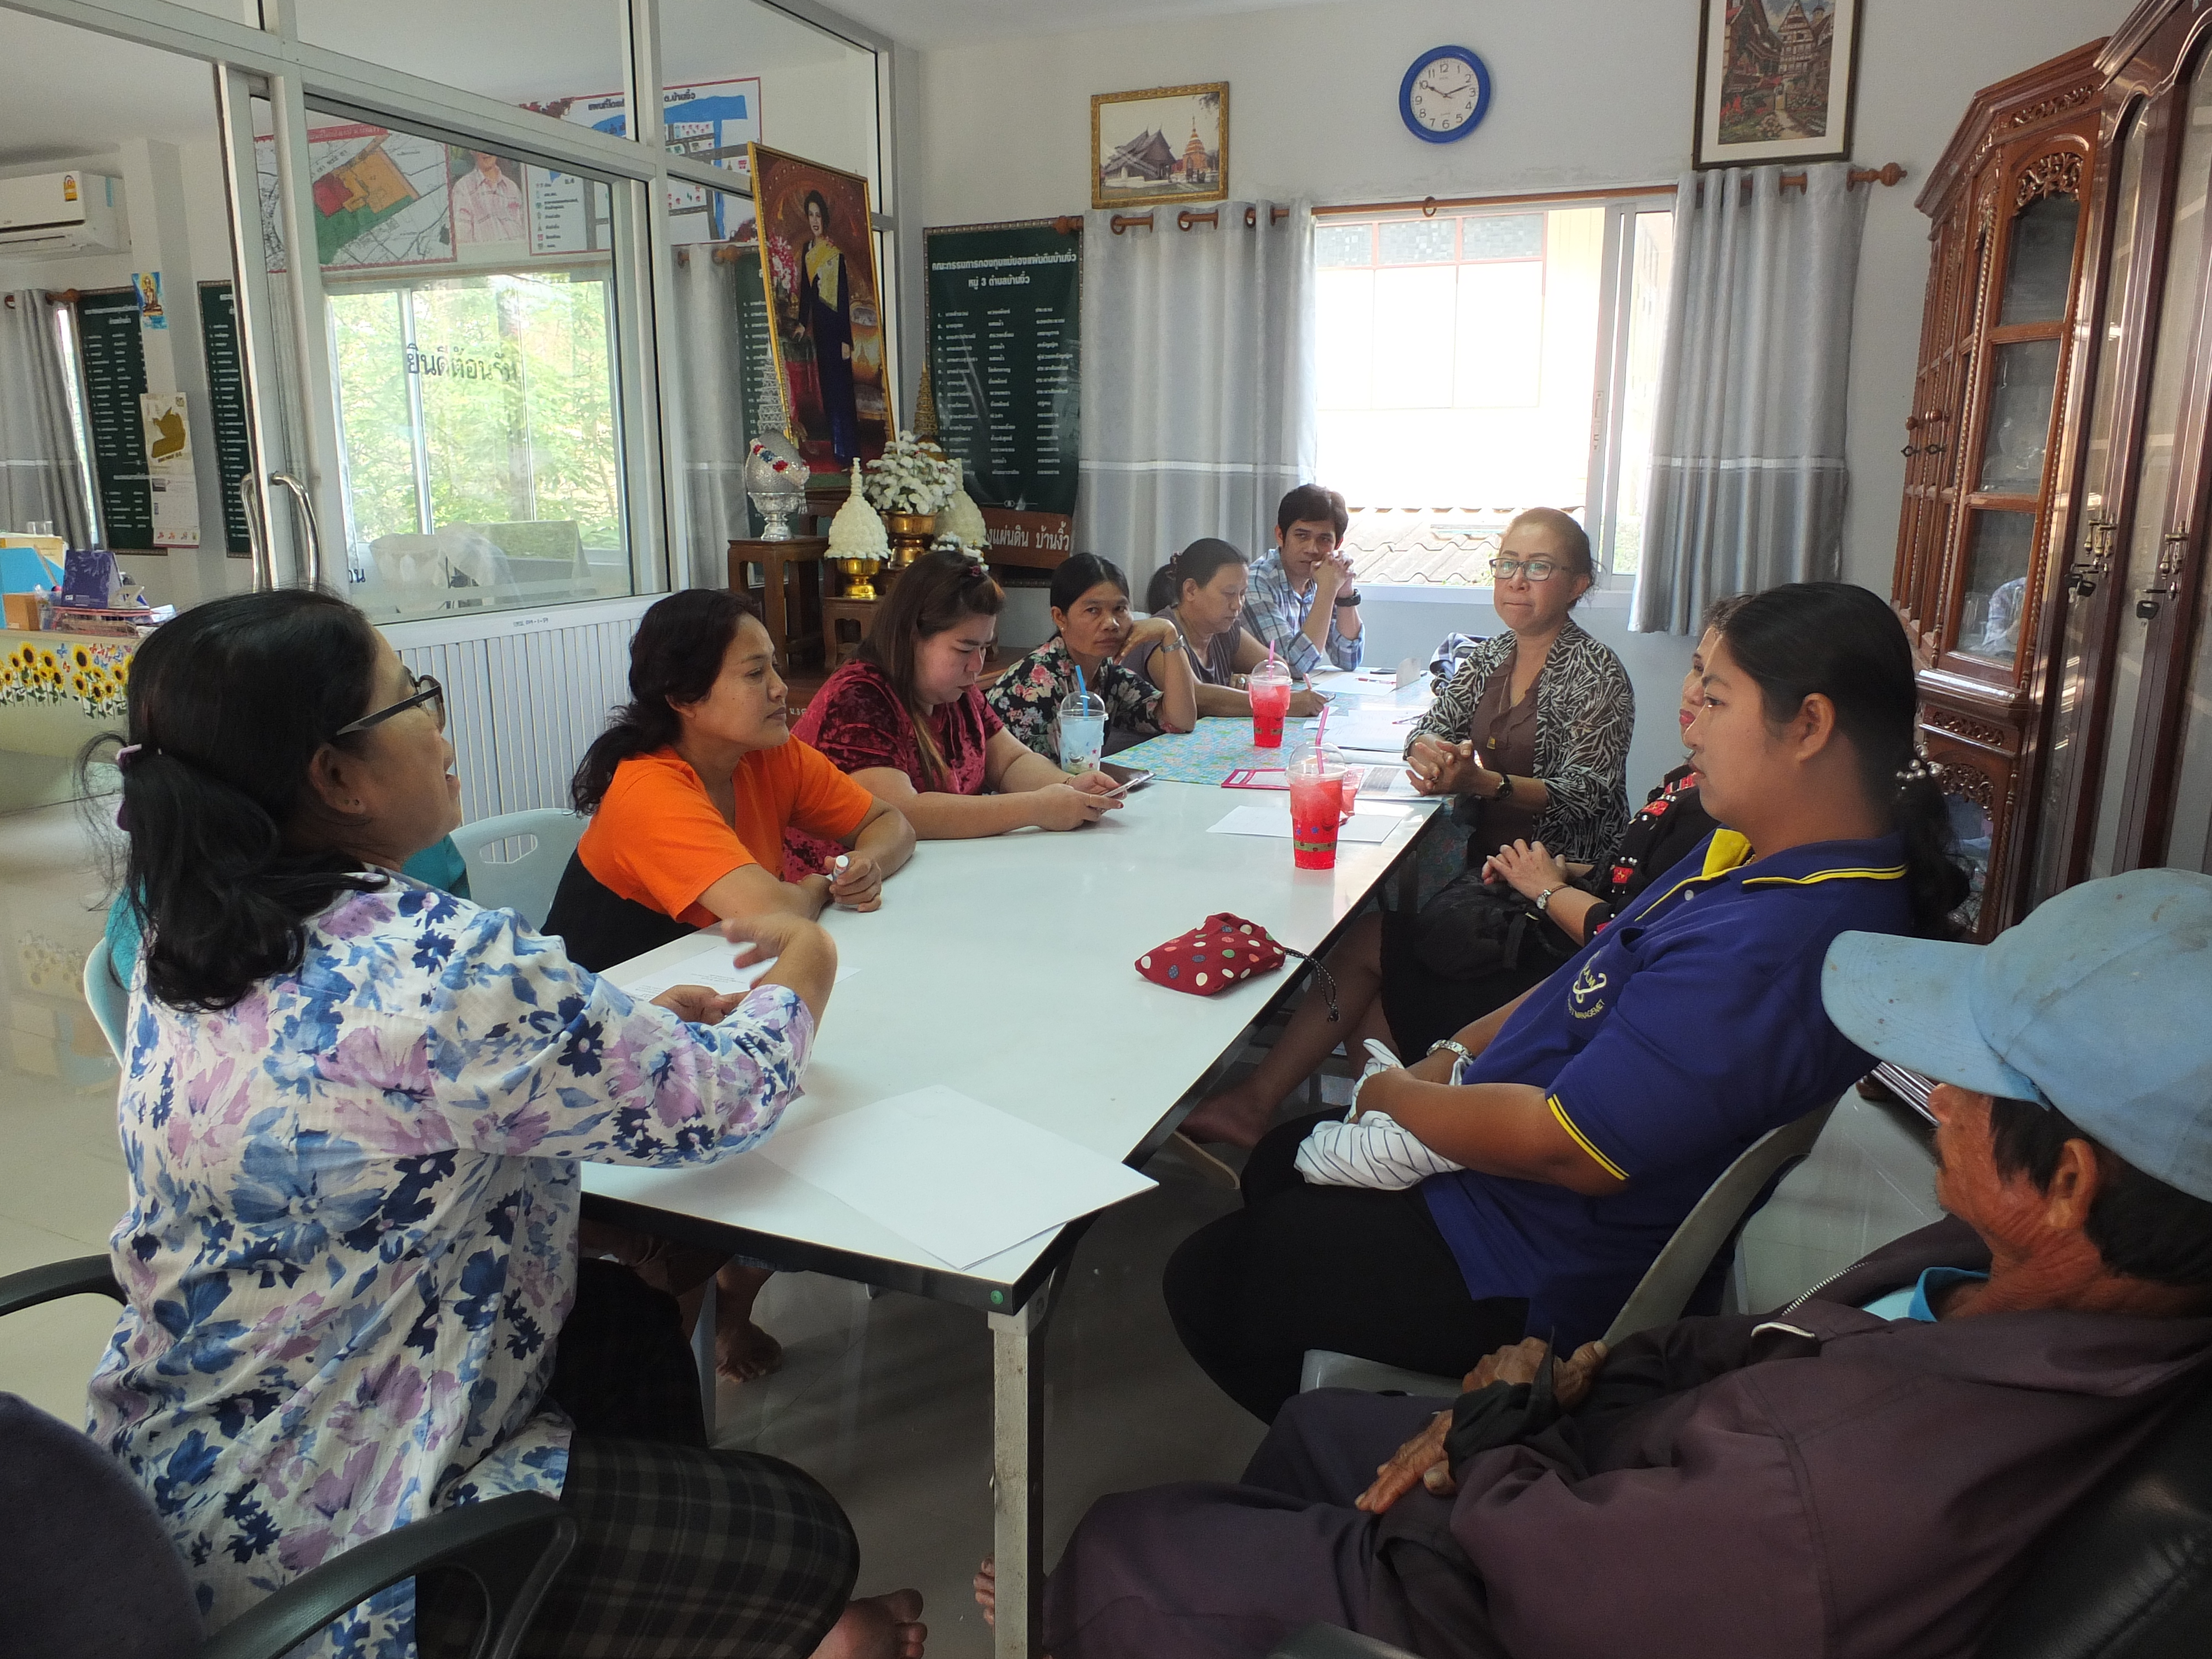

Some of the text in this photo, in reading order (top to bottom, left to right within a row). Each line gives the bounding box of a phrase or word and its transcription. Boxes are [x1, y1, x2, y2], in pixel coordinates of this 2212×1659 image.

[1439, 64, 1448, 73] 12
[1428, 69, 1435, 78] 11
[1465, 74, 1472, 83] 2
[1420, 80, 1428, 89] 10
[1469, 88, 1476, 97] 3
[1415, 96, 1422, 105] 9
[1419, 108, 1426, 118] 8
[1430, 118, 1436, 127] 7
[1455, 114, 1463, 123] 5
[1442, 119, 1449, 129] 6
[968, 270, 1030, 290] หมู่ 3 ตำบลบ้านงิ้ว
[1035, 520, 1070, 551] บ้านงิ้ว
